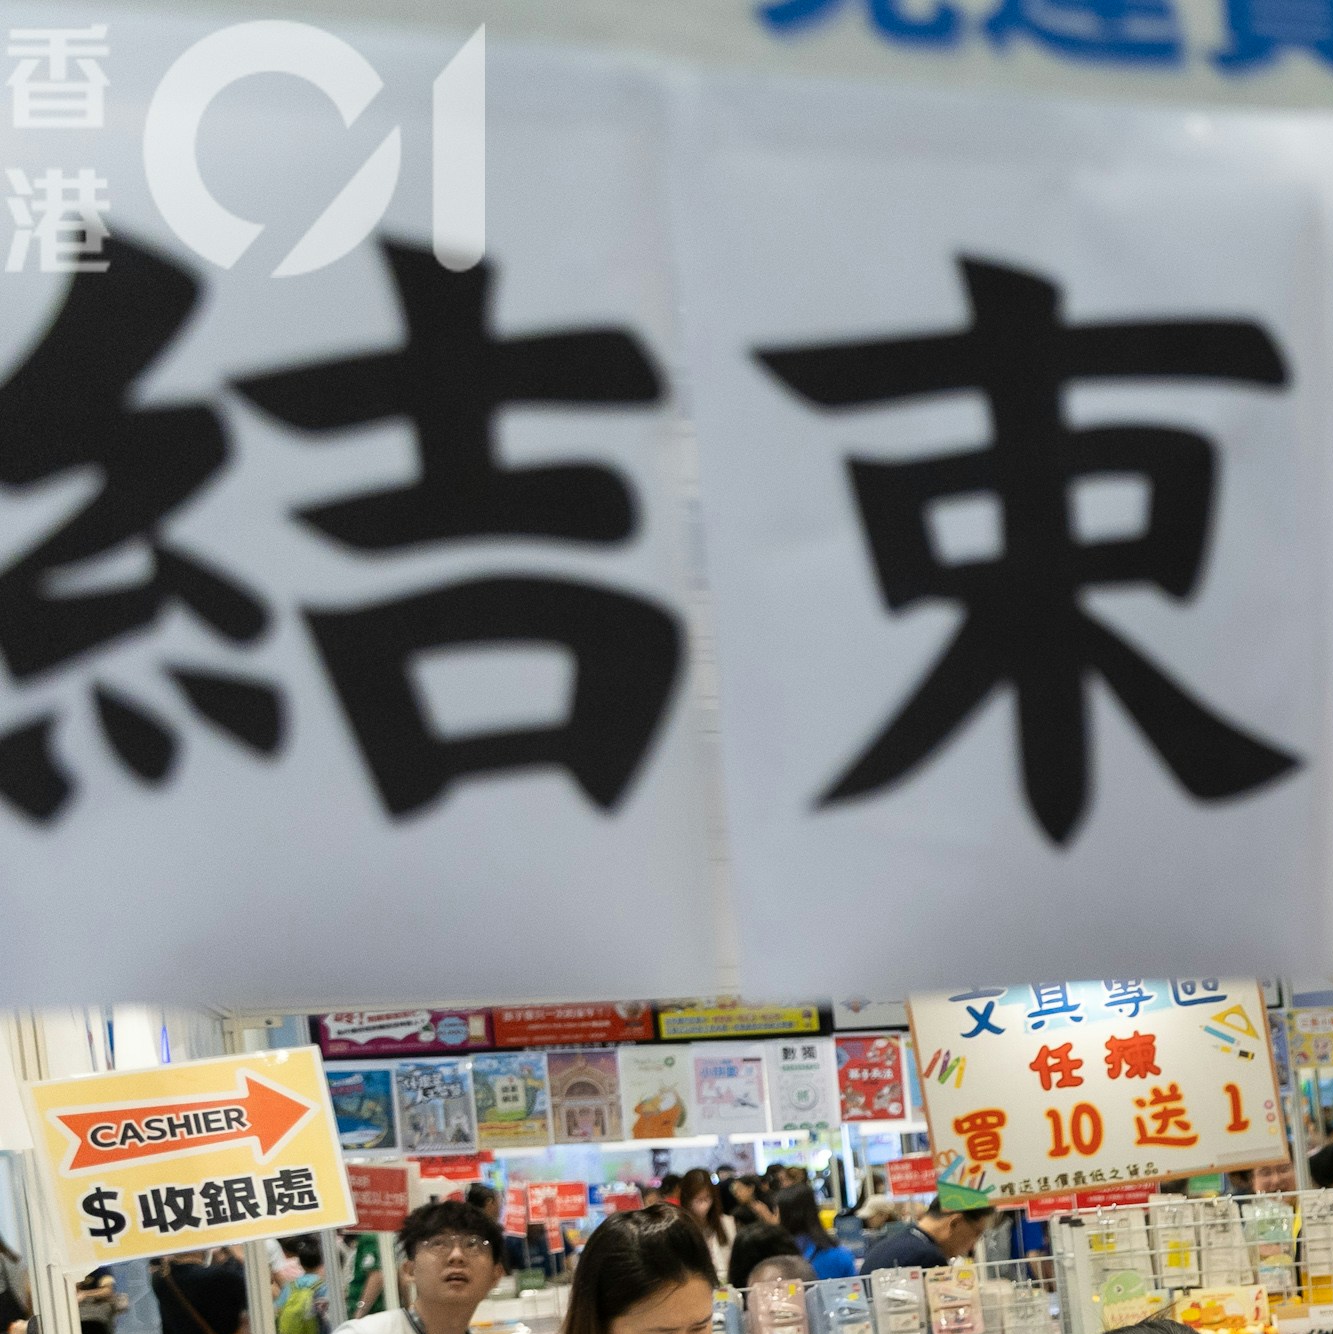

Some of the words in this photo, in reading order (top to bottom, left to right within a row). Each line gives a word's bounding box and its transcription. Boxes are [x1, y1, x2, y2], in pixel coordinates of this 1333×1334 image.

[948, 977, 1228, 1038] 文具專區
[1030, 1031, 1162, 1090] 任揀
[88, 1106, 247, 1150] CASHIER
[82, 1187, 126, 1241] $
[141, 1168, 319, 1234] 收銀處
